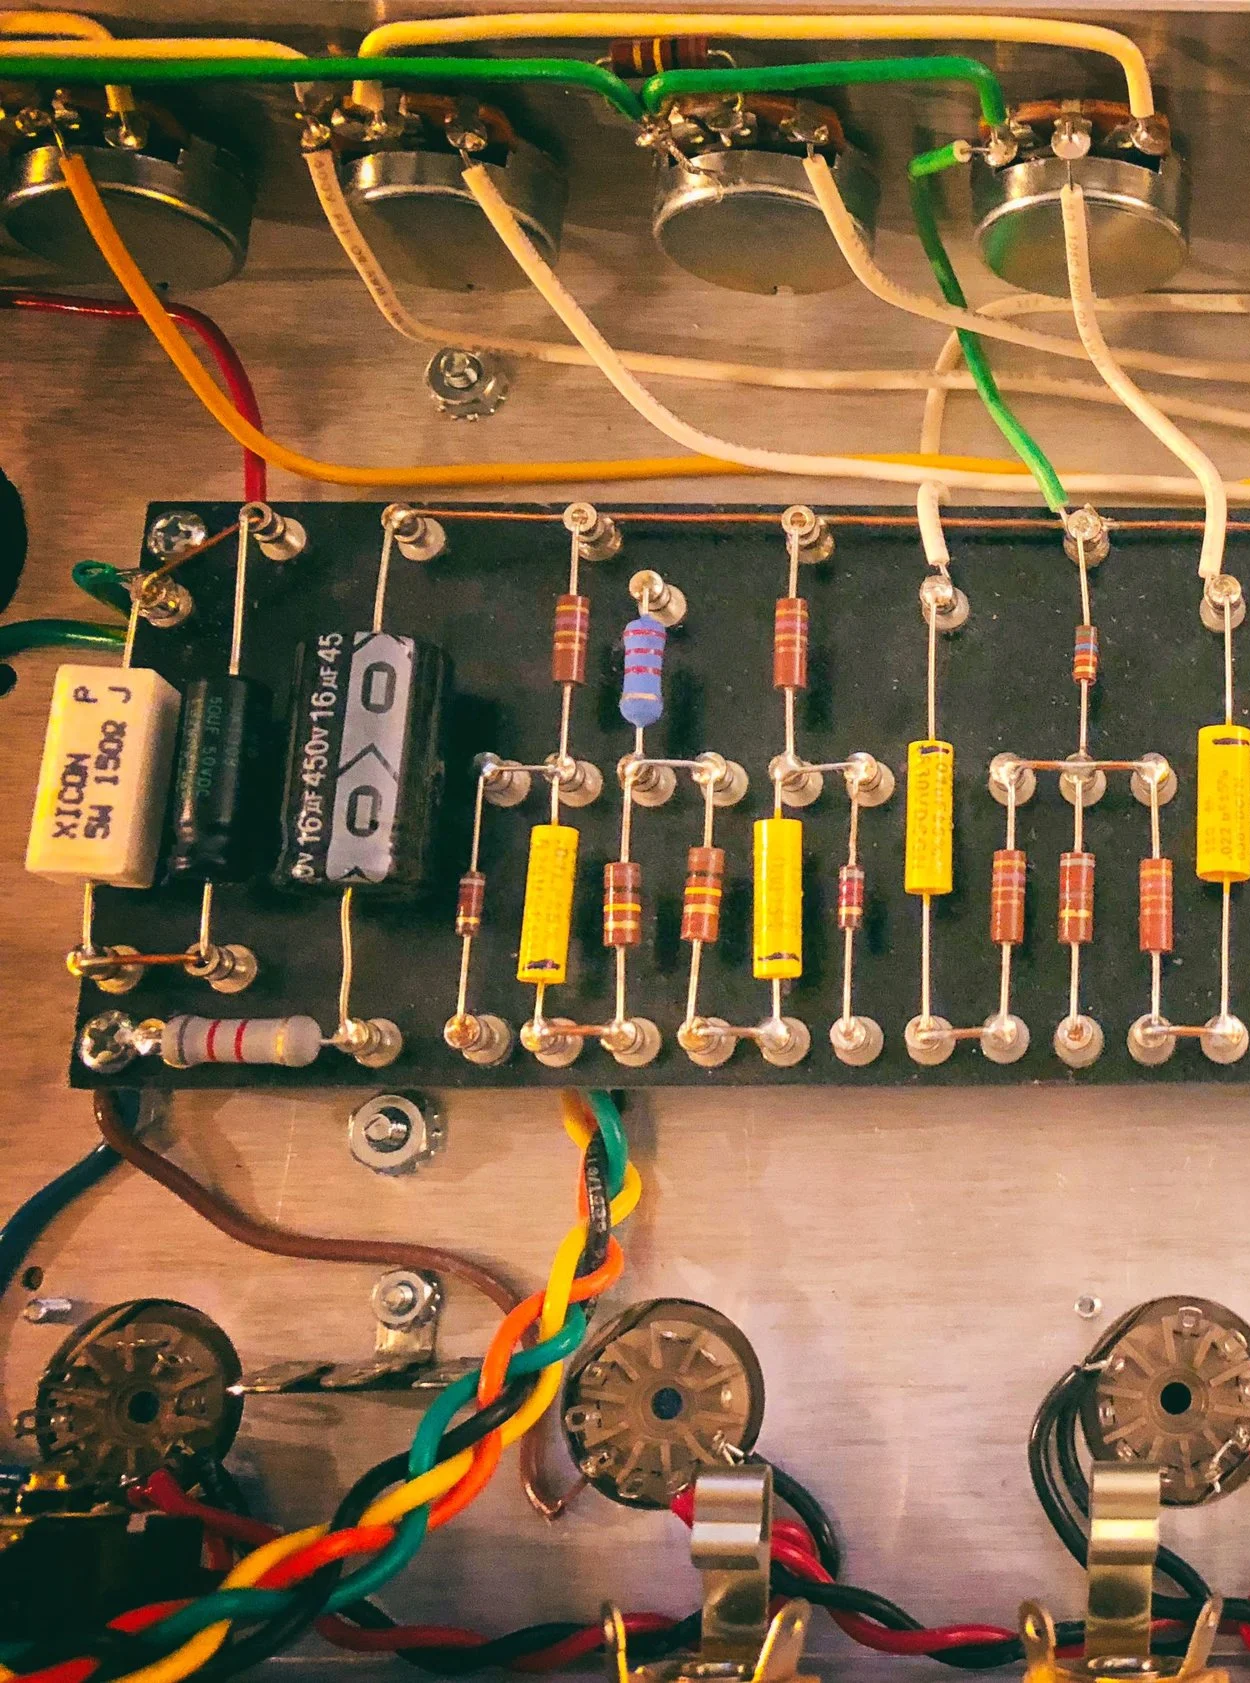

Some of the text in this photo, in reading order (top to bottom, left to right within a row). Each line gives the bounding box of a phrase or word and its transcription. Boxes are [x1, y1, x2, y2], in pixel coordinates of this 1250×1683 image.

[52, 685, 98, 839] XICON P
[83, 805, 114, 839] 5W
[107, 686, 132, 704] J
